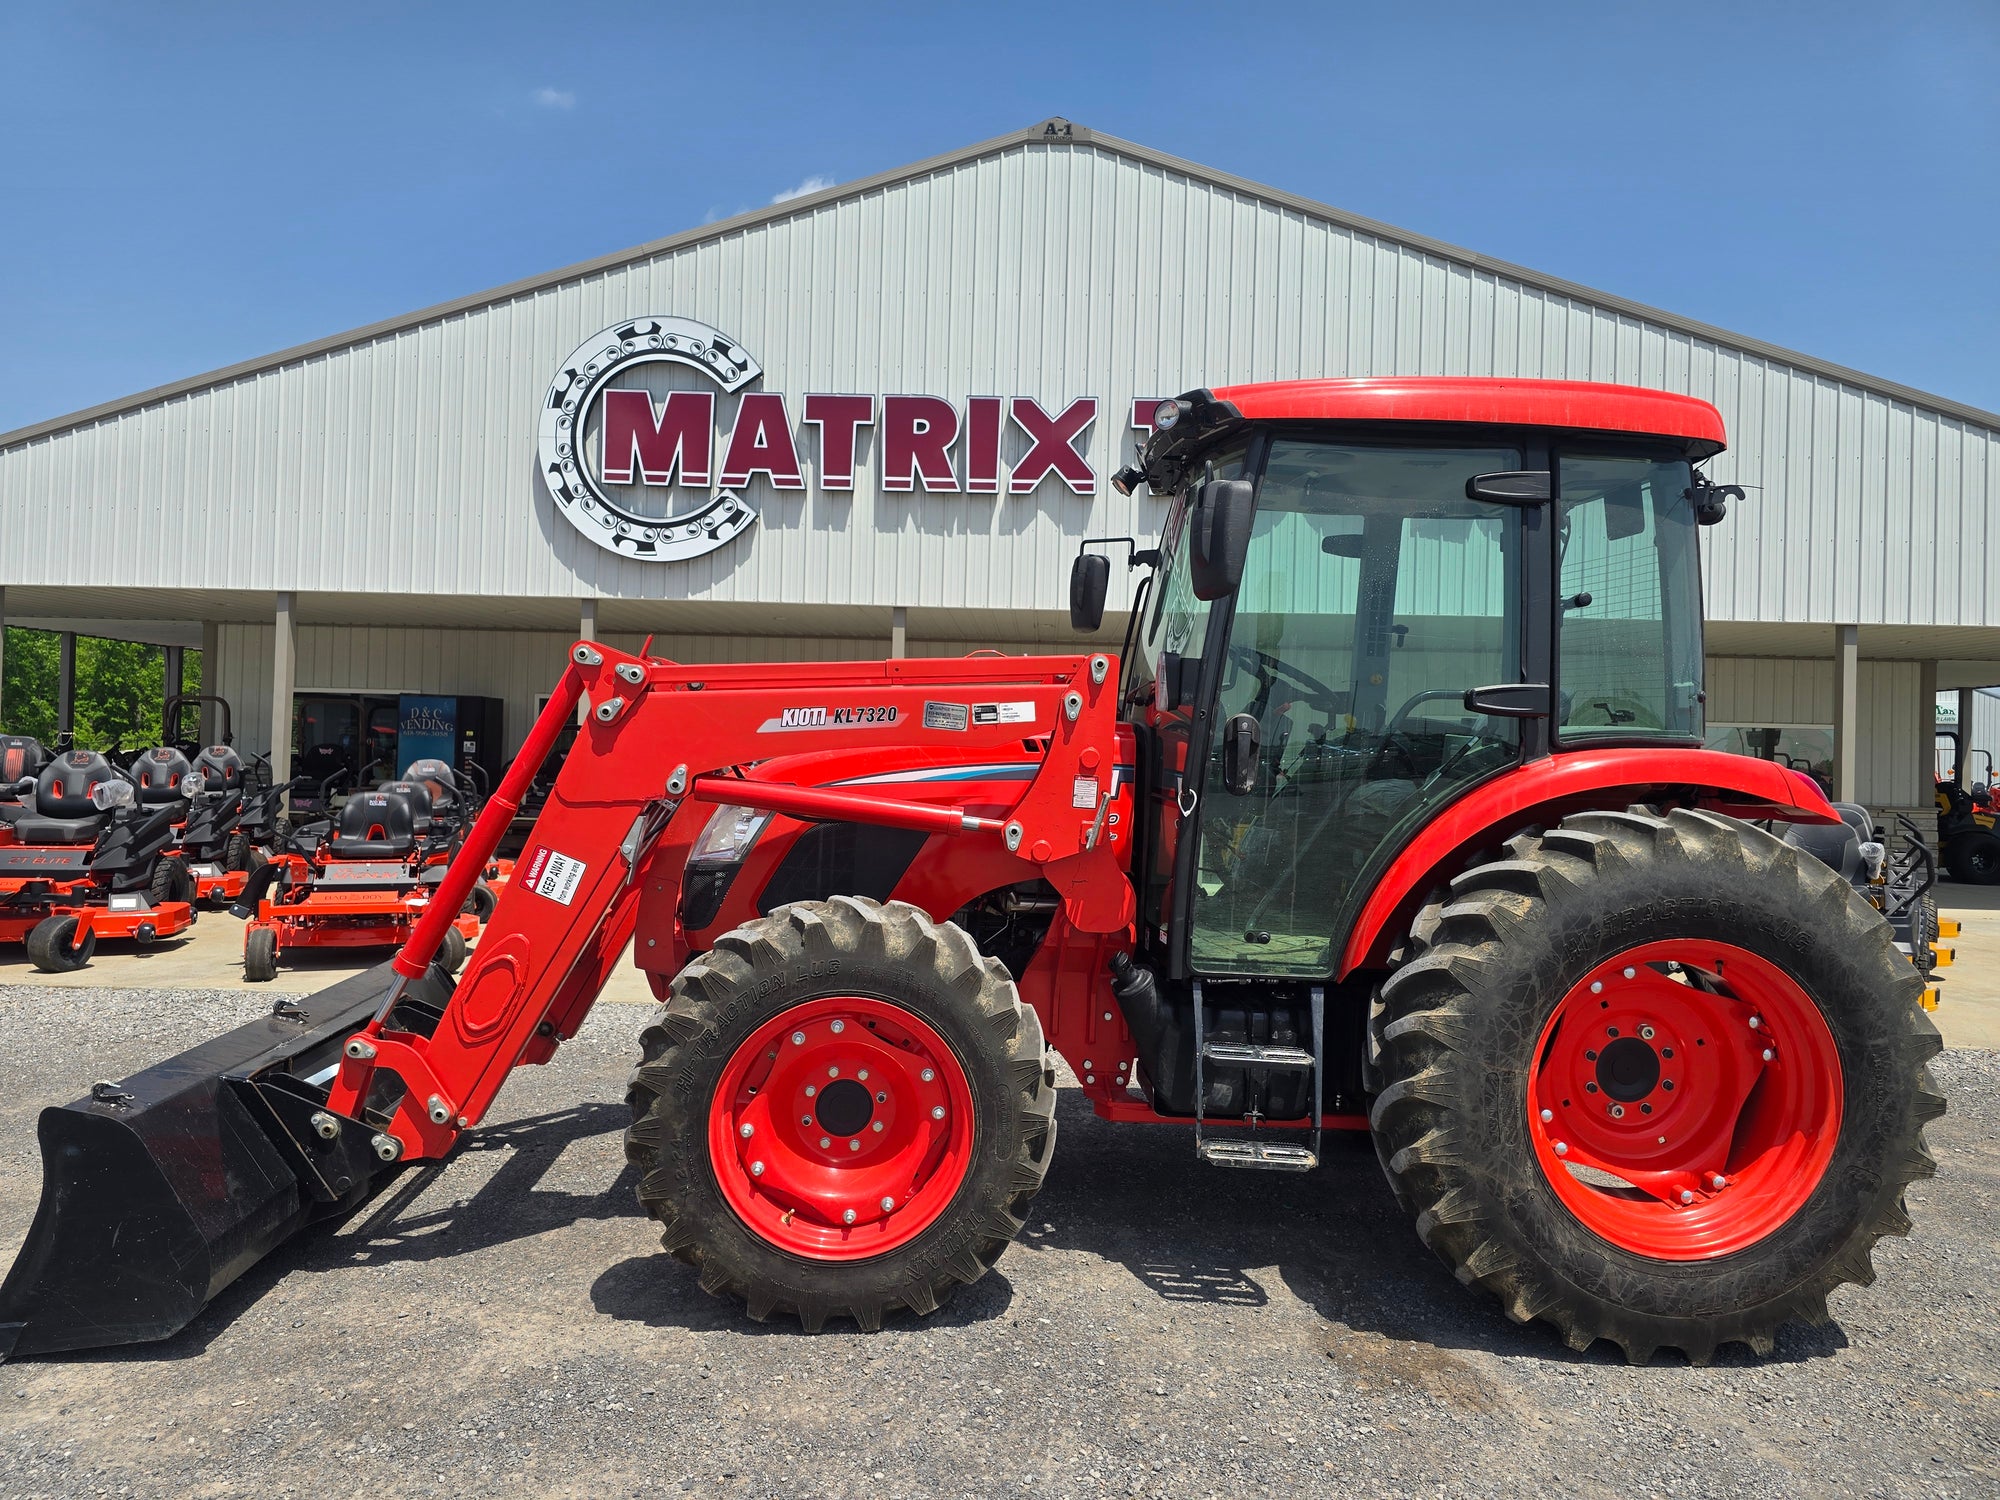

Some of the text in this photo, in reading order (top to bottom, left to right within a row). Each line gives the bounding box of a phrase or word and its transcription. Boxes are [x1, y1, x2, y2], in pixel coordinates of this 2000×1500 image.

[1044, 122, 1073, 135] A-1
[602, 389, 1098, 495] MATRIX
[411, 706, 442, 719] D & C
[781, 706, 898, 728] KIOTI KL7320
[400, 718, 454, 732] VENDING
[8, 856, 72, 865] ZT ELITE
[528, 848, 548, 878] WARNING
[541, 855, 566, 897] KEEP AWAY
[1759, 913, 1816, 951] LUG
[794, 959, 841, 983] LUG
[904, 1209, 985, 1284] TITAN
